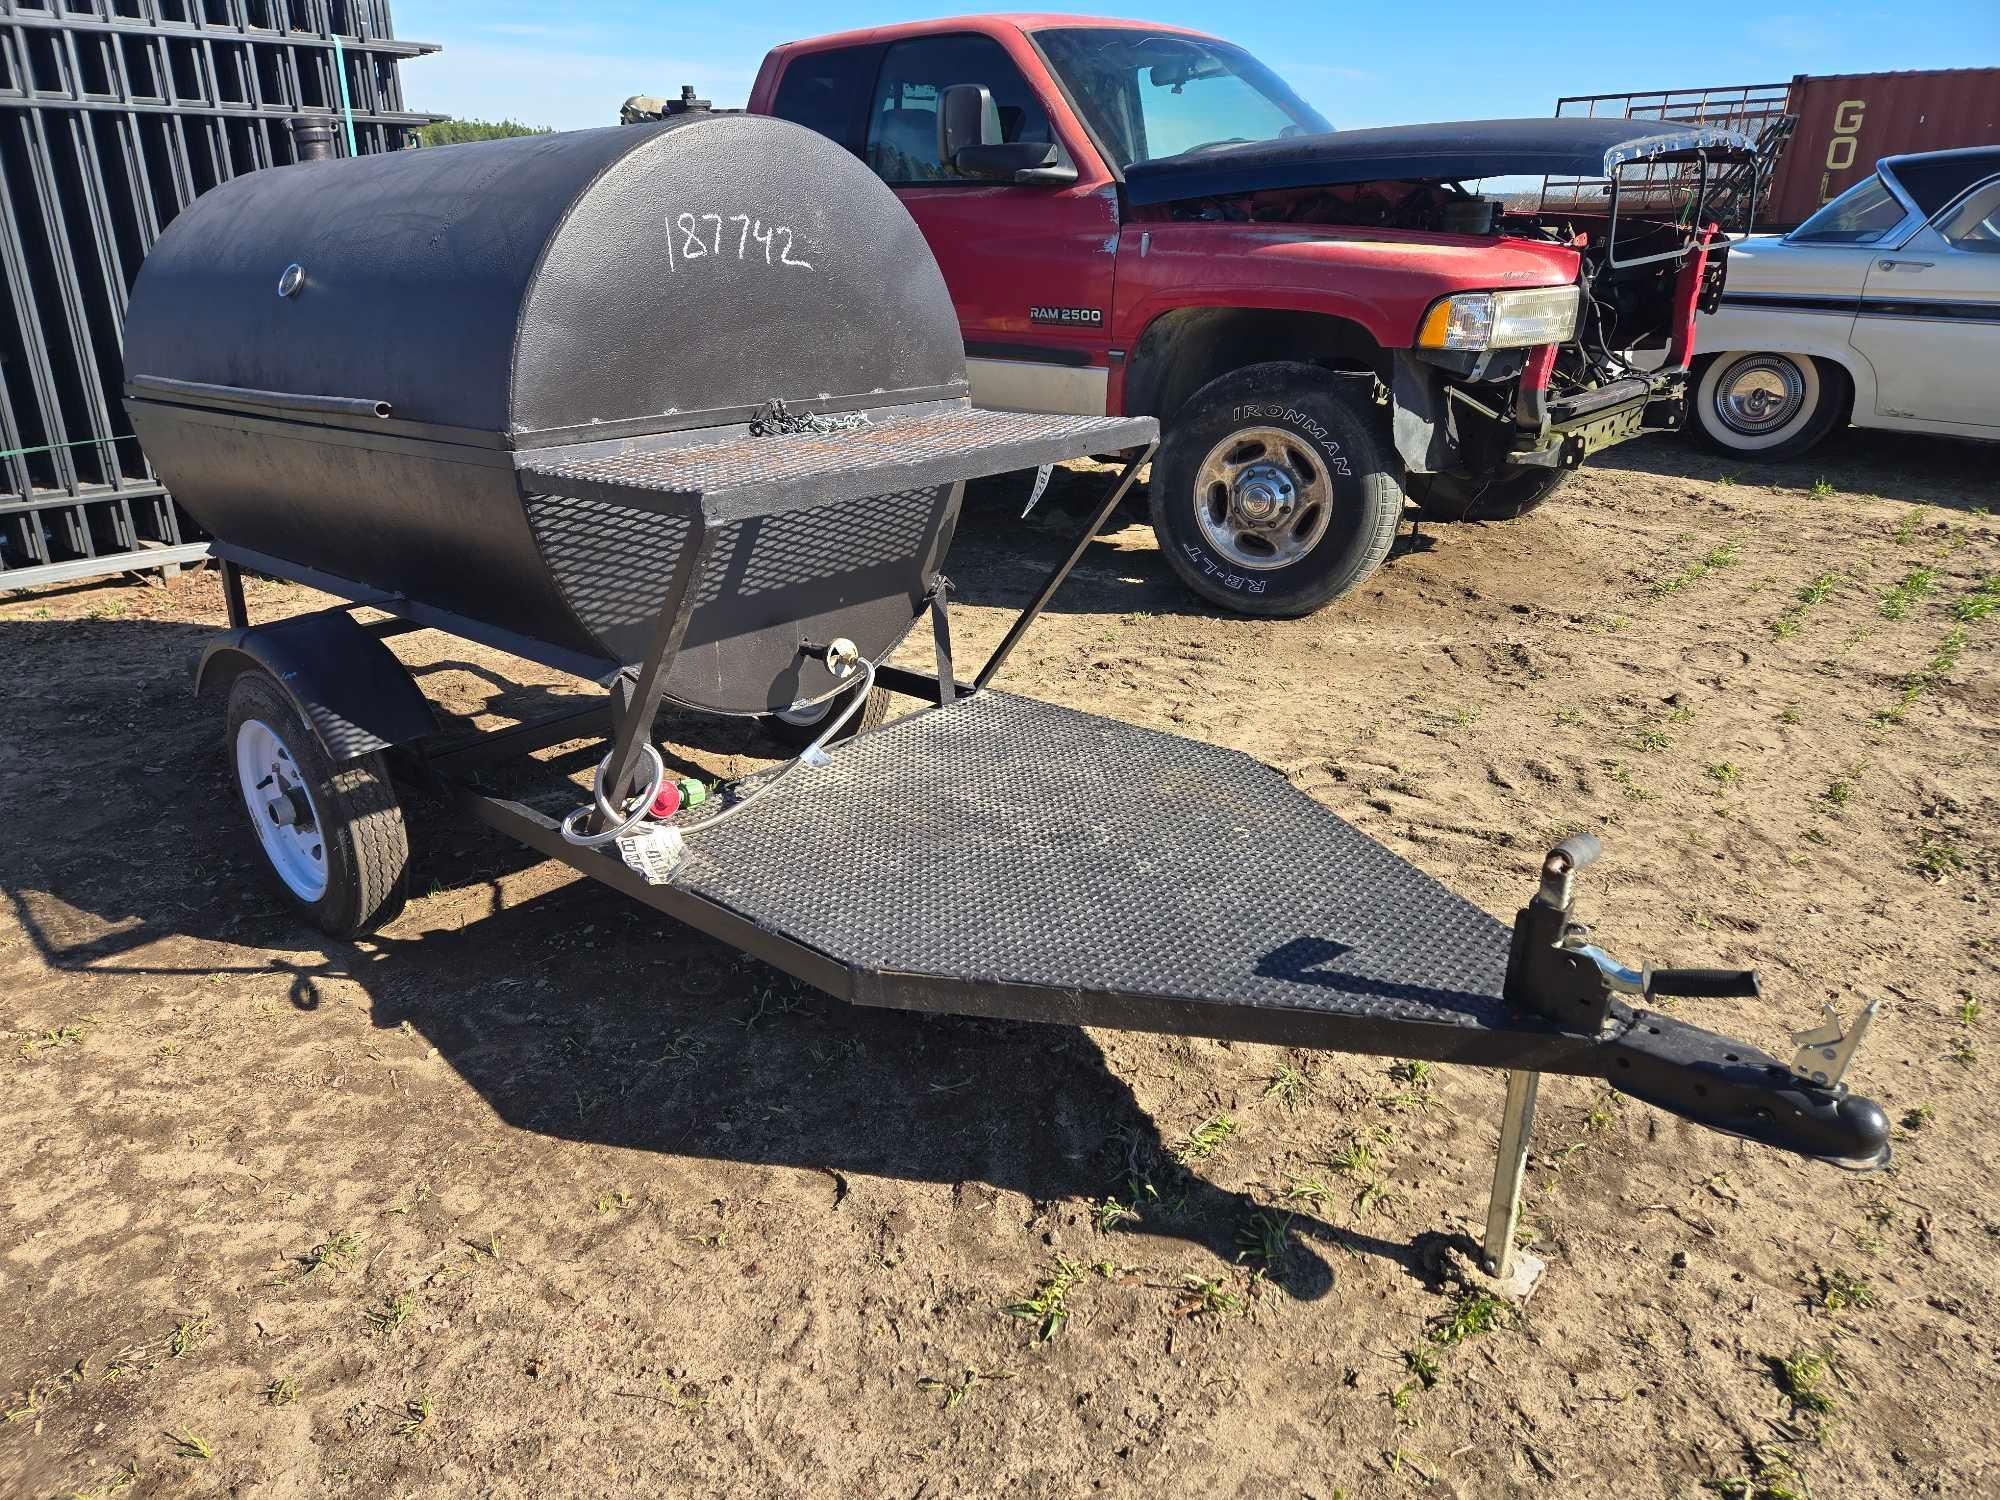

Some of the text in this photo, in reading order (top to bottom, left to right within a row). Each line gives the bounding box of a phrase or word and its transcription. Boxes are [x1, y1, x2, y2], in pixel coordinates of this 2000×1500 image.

[664, 212, 815, 273] 187742
[1030, 307, 1101, 321] RAM 2500
[1233, 405, 1351, 476] IRONMAN
